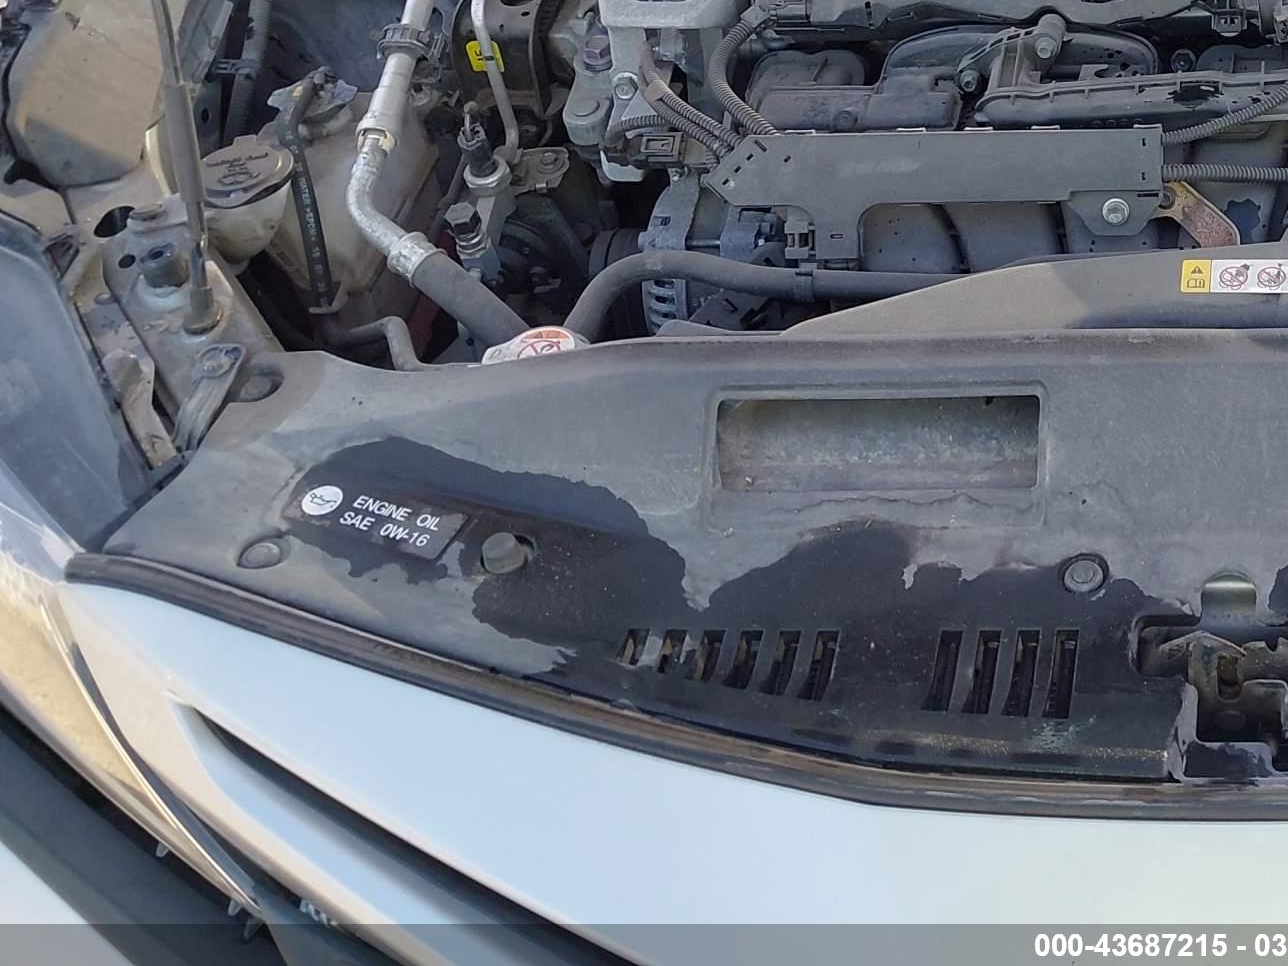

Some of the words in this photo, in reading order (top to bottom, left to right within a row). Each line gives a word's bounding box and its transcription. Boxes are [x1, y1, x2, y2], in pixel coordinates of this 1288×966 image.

[339, 511, 376, 531] SAE
[380, 523, 431, 548] 0W-16
[353, 495, 412, 522] ENGINE
[416, 513, 441, 531] OIL
